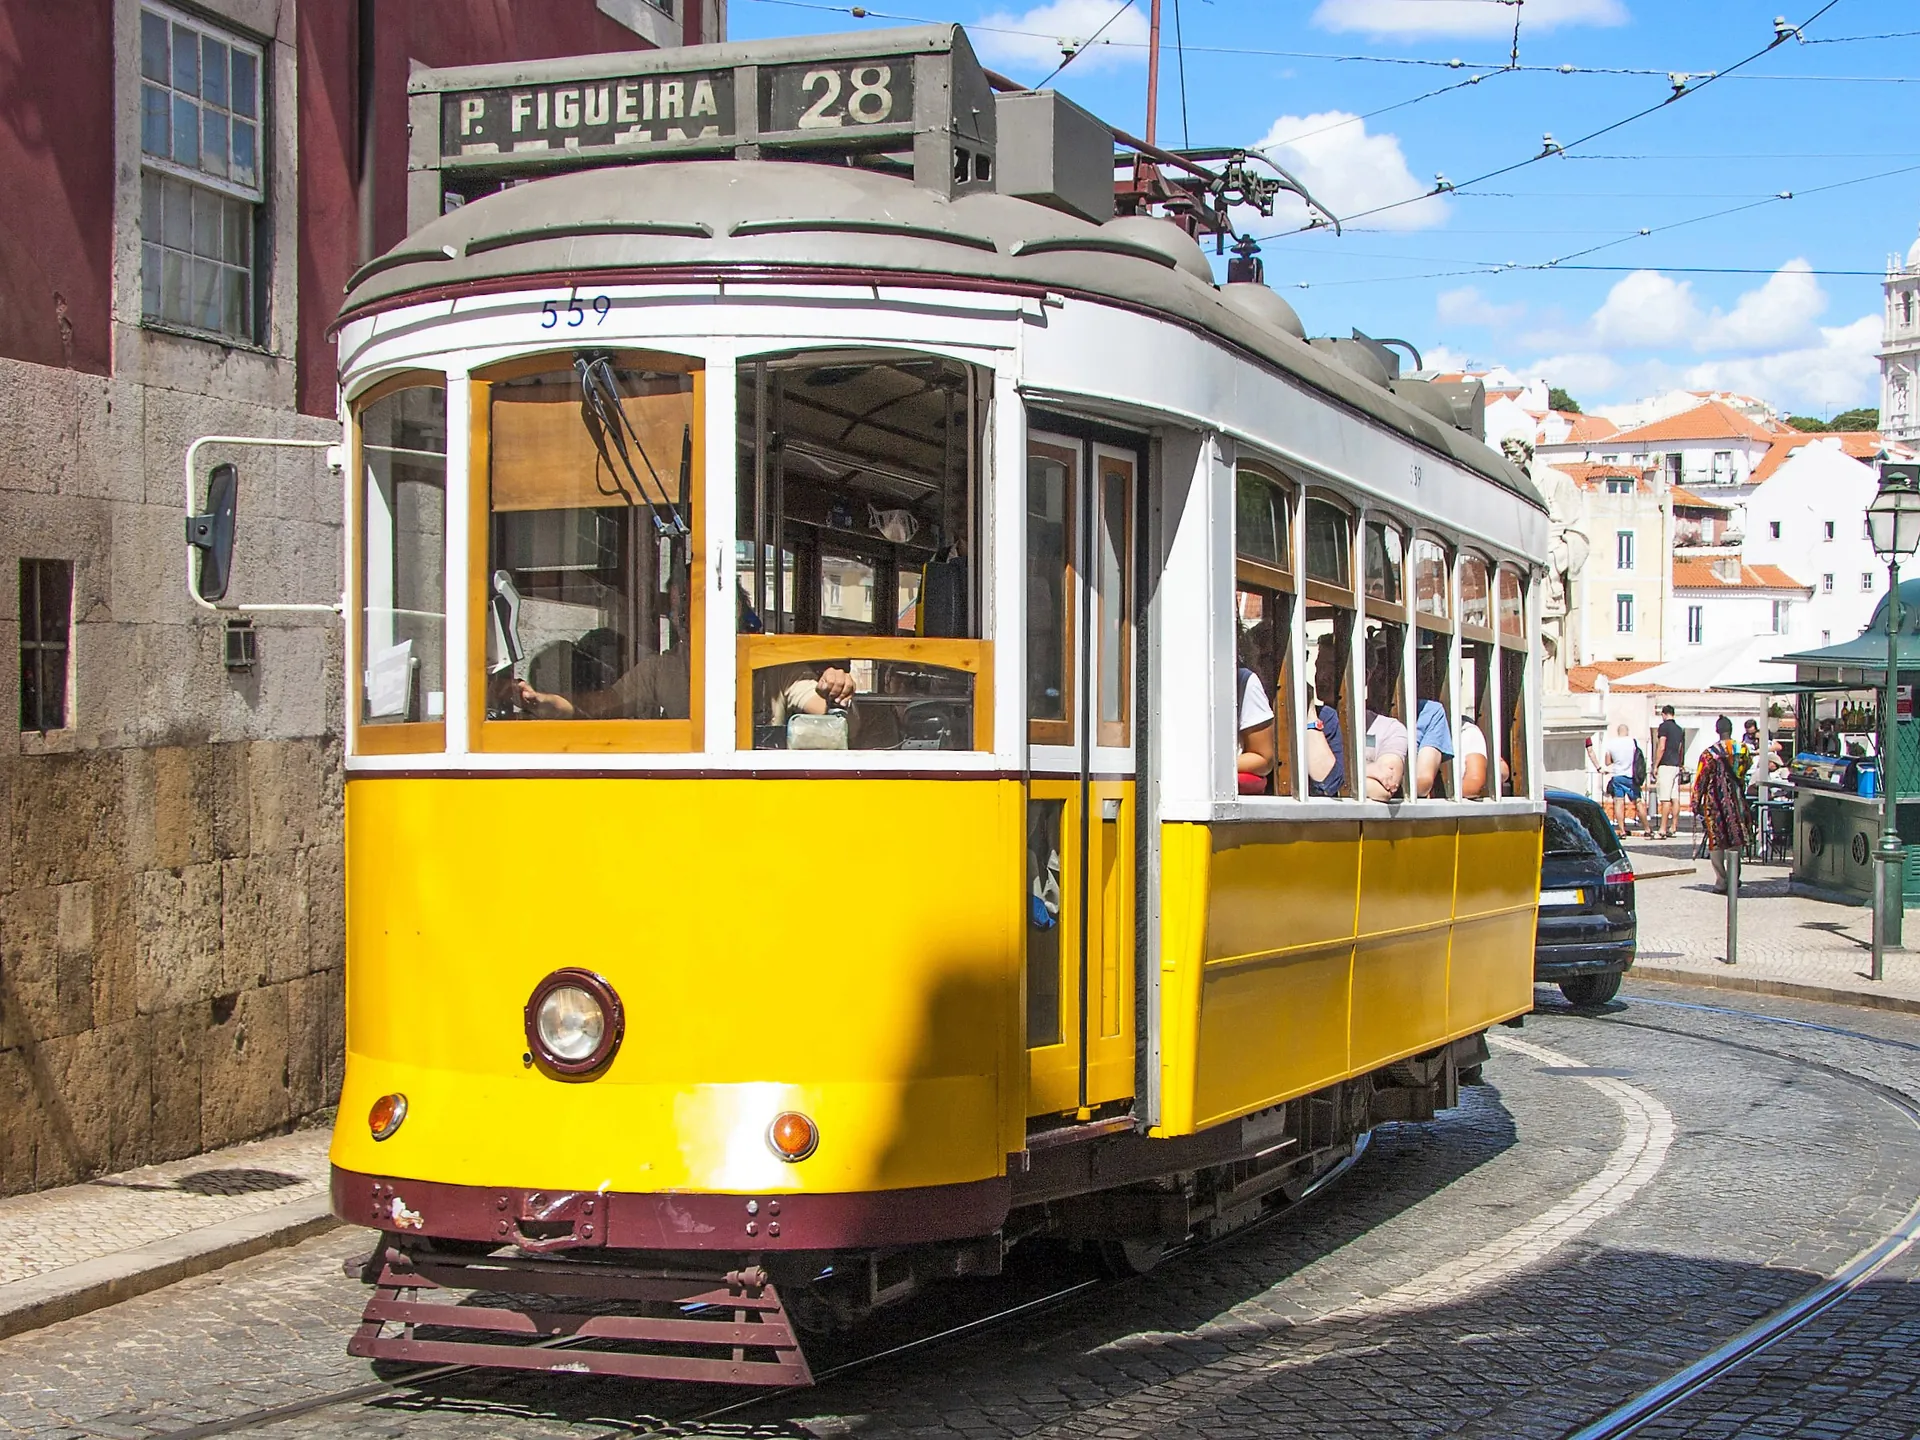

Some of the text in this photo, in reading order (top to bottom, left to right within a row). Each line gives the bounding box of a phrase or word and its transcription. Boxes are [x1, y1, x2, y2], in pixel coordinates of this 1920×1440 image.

[461, 79, 718, 135] P. FIGUEIRA
[799, 66, 893, 128] 28
[541, 294, 611, 329] 559
